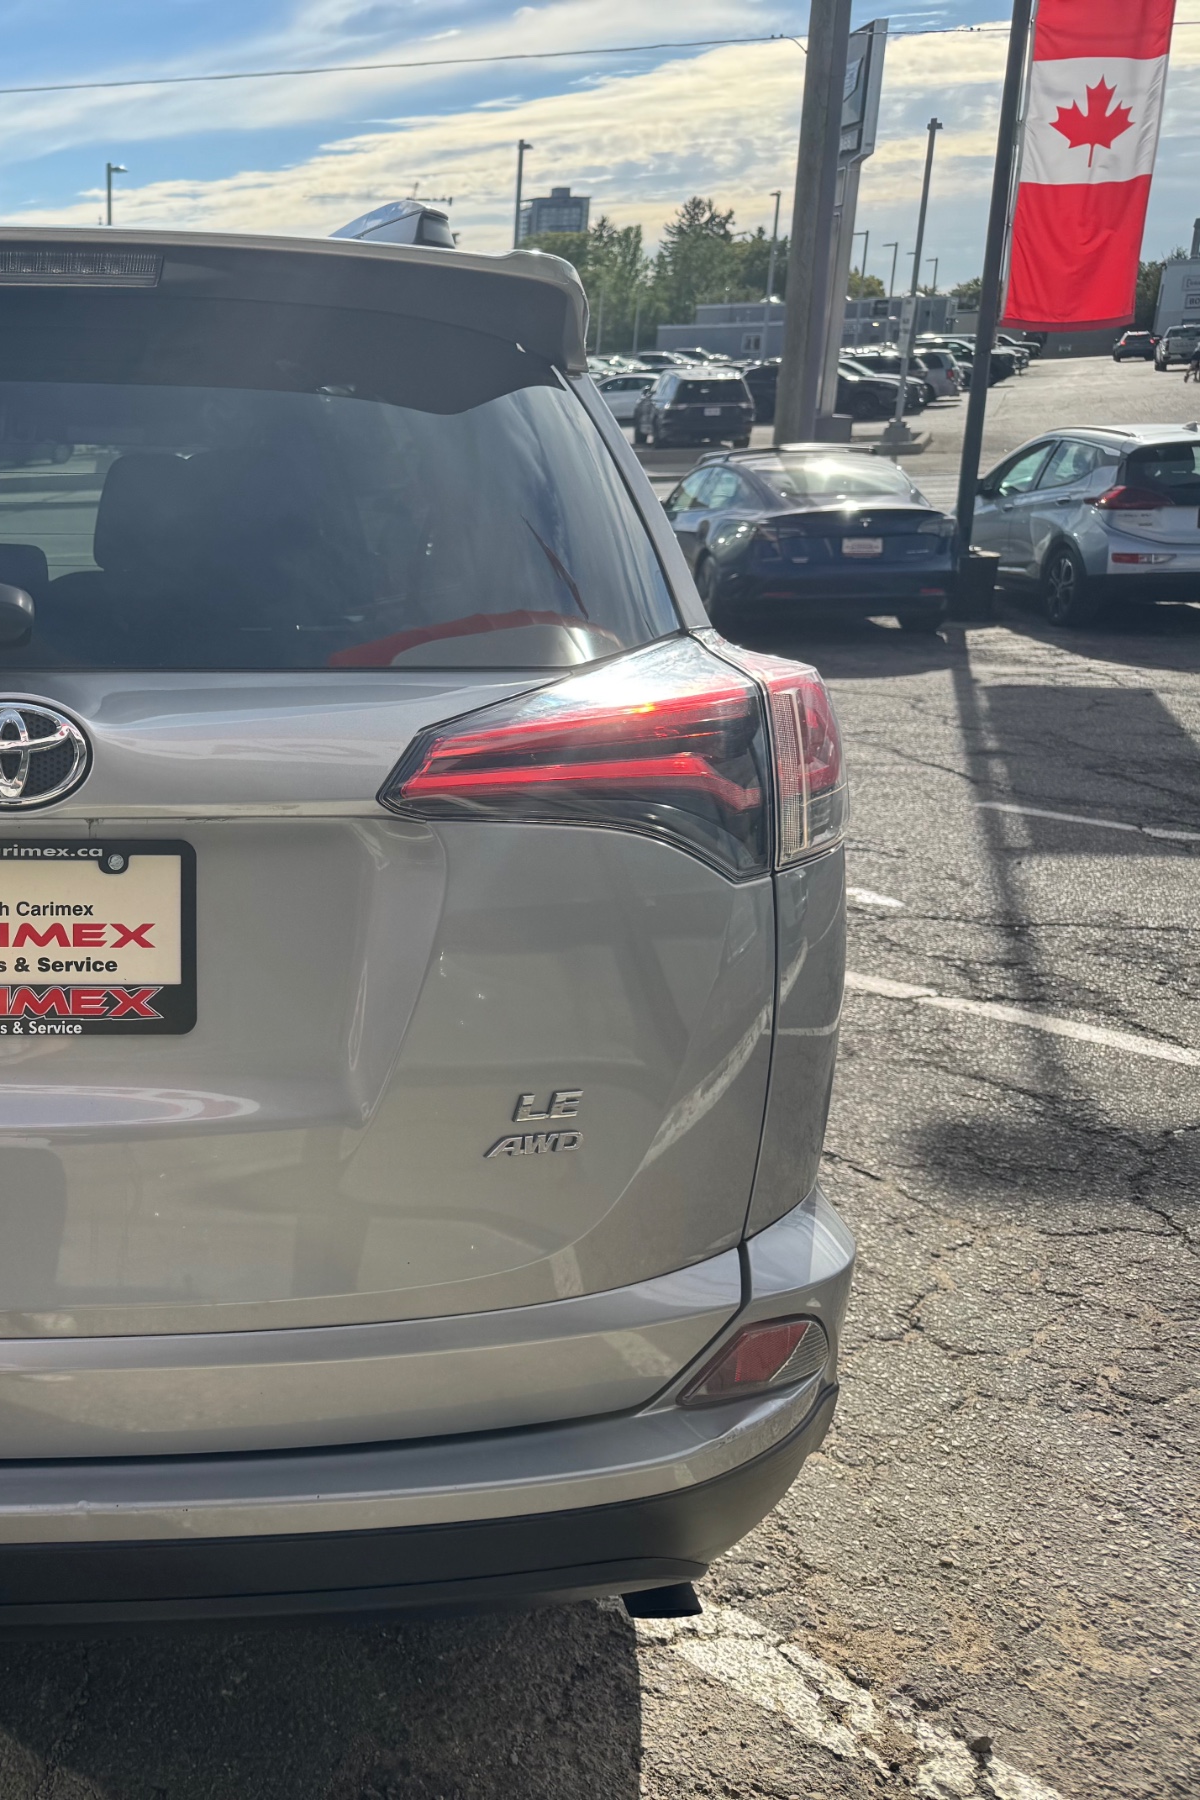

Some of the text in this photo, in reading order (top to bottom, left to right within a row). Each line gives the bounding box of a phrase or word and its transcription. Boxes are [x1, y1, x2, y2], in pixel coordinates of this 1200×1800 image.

[16, 901, 94, 917] Carimex
[14, 957, 30, 972] &
[37, 957, 118, 973] Service
[13, 1021, 24, 1034] &
[29, 1021, 83, 1035] Service
[512, 1089, 584, 1122] LE
[483, 1130, 584, 1158] AWD
